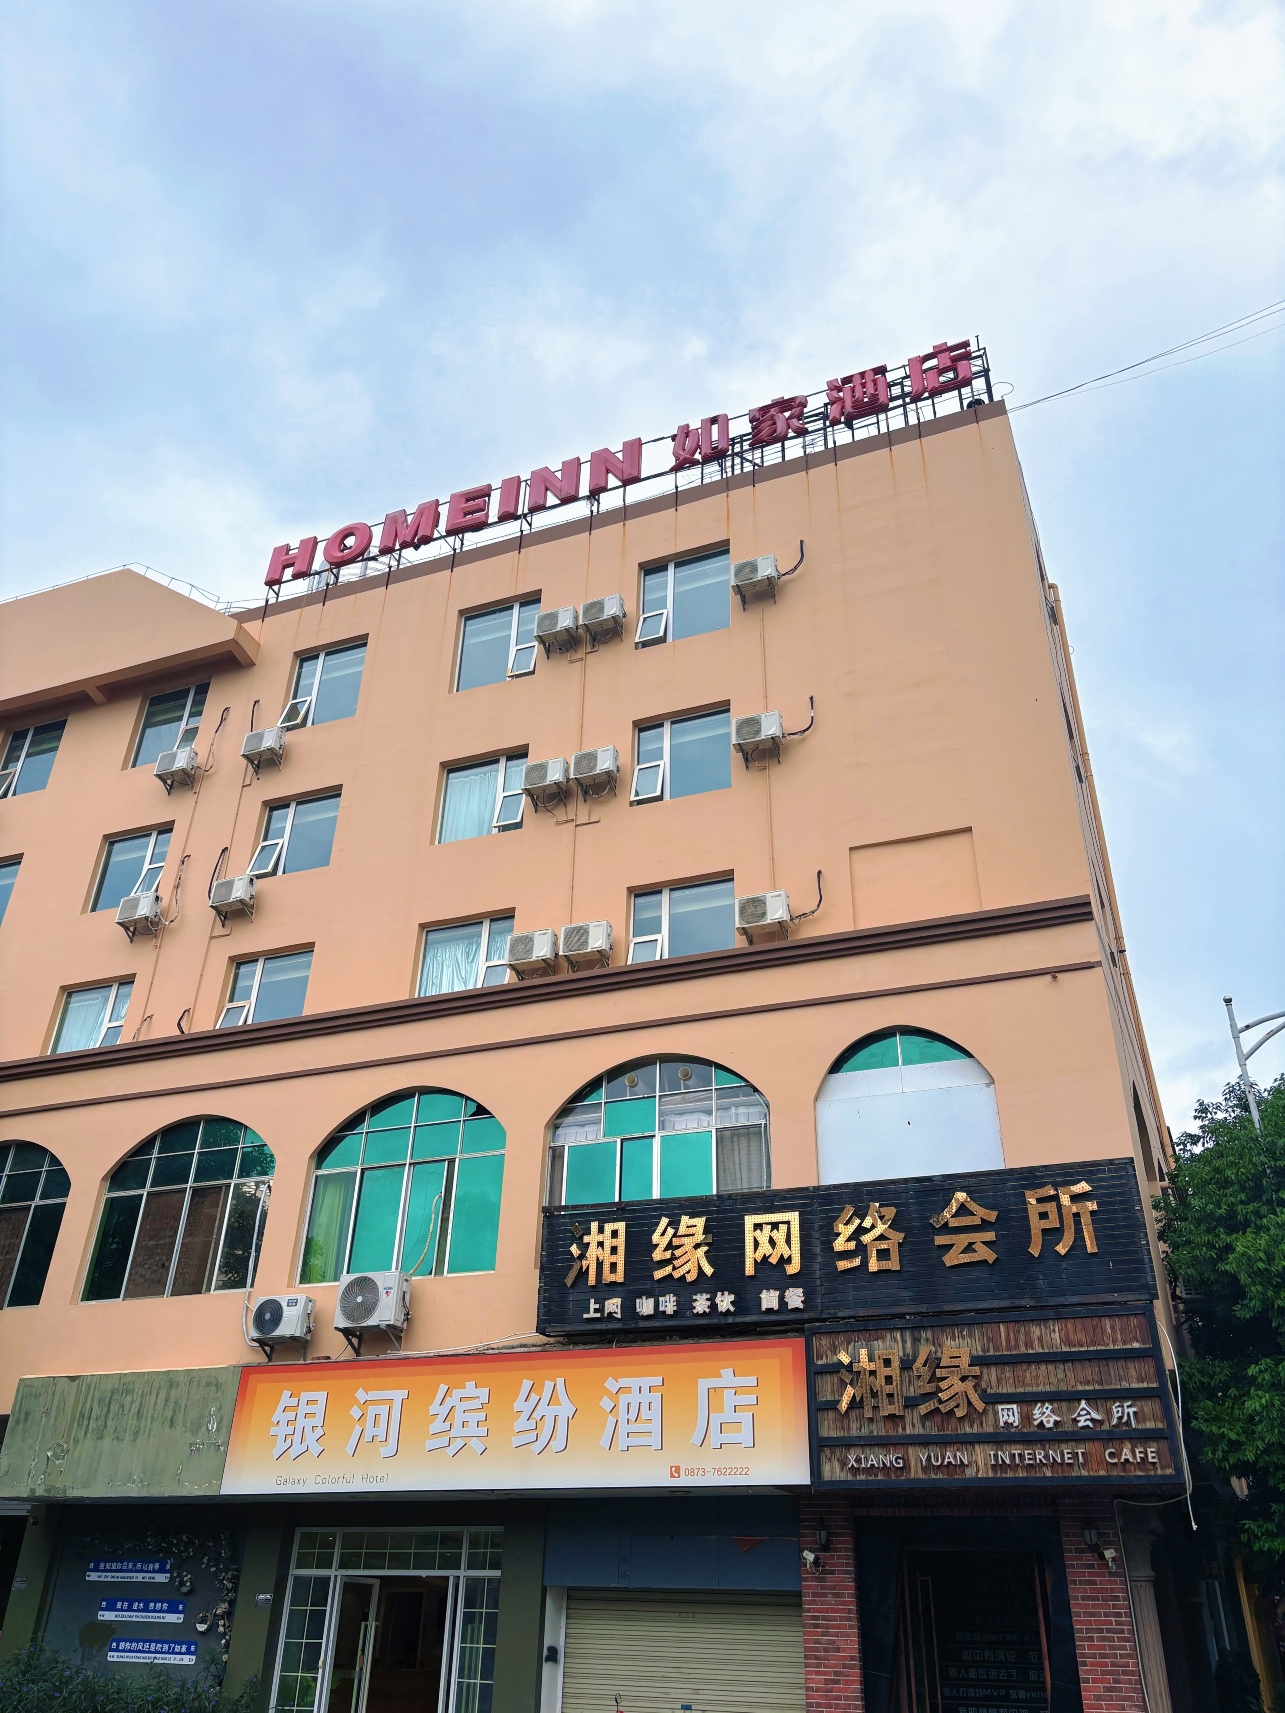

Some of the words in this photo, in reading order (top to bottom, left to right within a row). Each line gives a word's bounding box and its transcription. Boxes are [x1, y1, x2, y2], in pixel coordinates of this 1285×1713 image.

[669, 339, 973, 472] 如家酒店
[264, 437, 642, 586] HOMEINN
[563, 1180, 1099, 1288] 湘缘网络会所
[582, 1298, 622, 1319] 上网
[635, 1294, 678, 1316] 咖啡
[691, 1291, 735, 1314] 茶饮
[759, 1287, 805, 1312] 简餐
[837, 1345, 986, 1418] 湘缘
[269, 1368, 759, 1461] 银河缤纷酒店
[998, 1399, 1138, 1430] 网络会所
[684, 1466, 750, 1477] 0873-7622222
[847, 1454, 904, 1468] XIANG
[919, 1451, 969, 1466] YUAN
[989, 1449, 1085, 1465] INTERNET
[1105, 1448, 1158, 1463] CAFE
[275, 1476, 308, 1487] Galaxy
[314, 1474, 355, 1485] Colorful
[361, 1473, 389, 1484] Hotel
[118, 1641, 188, 1653] 想你的风还是吹到了如家
